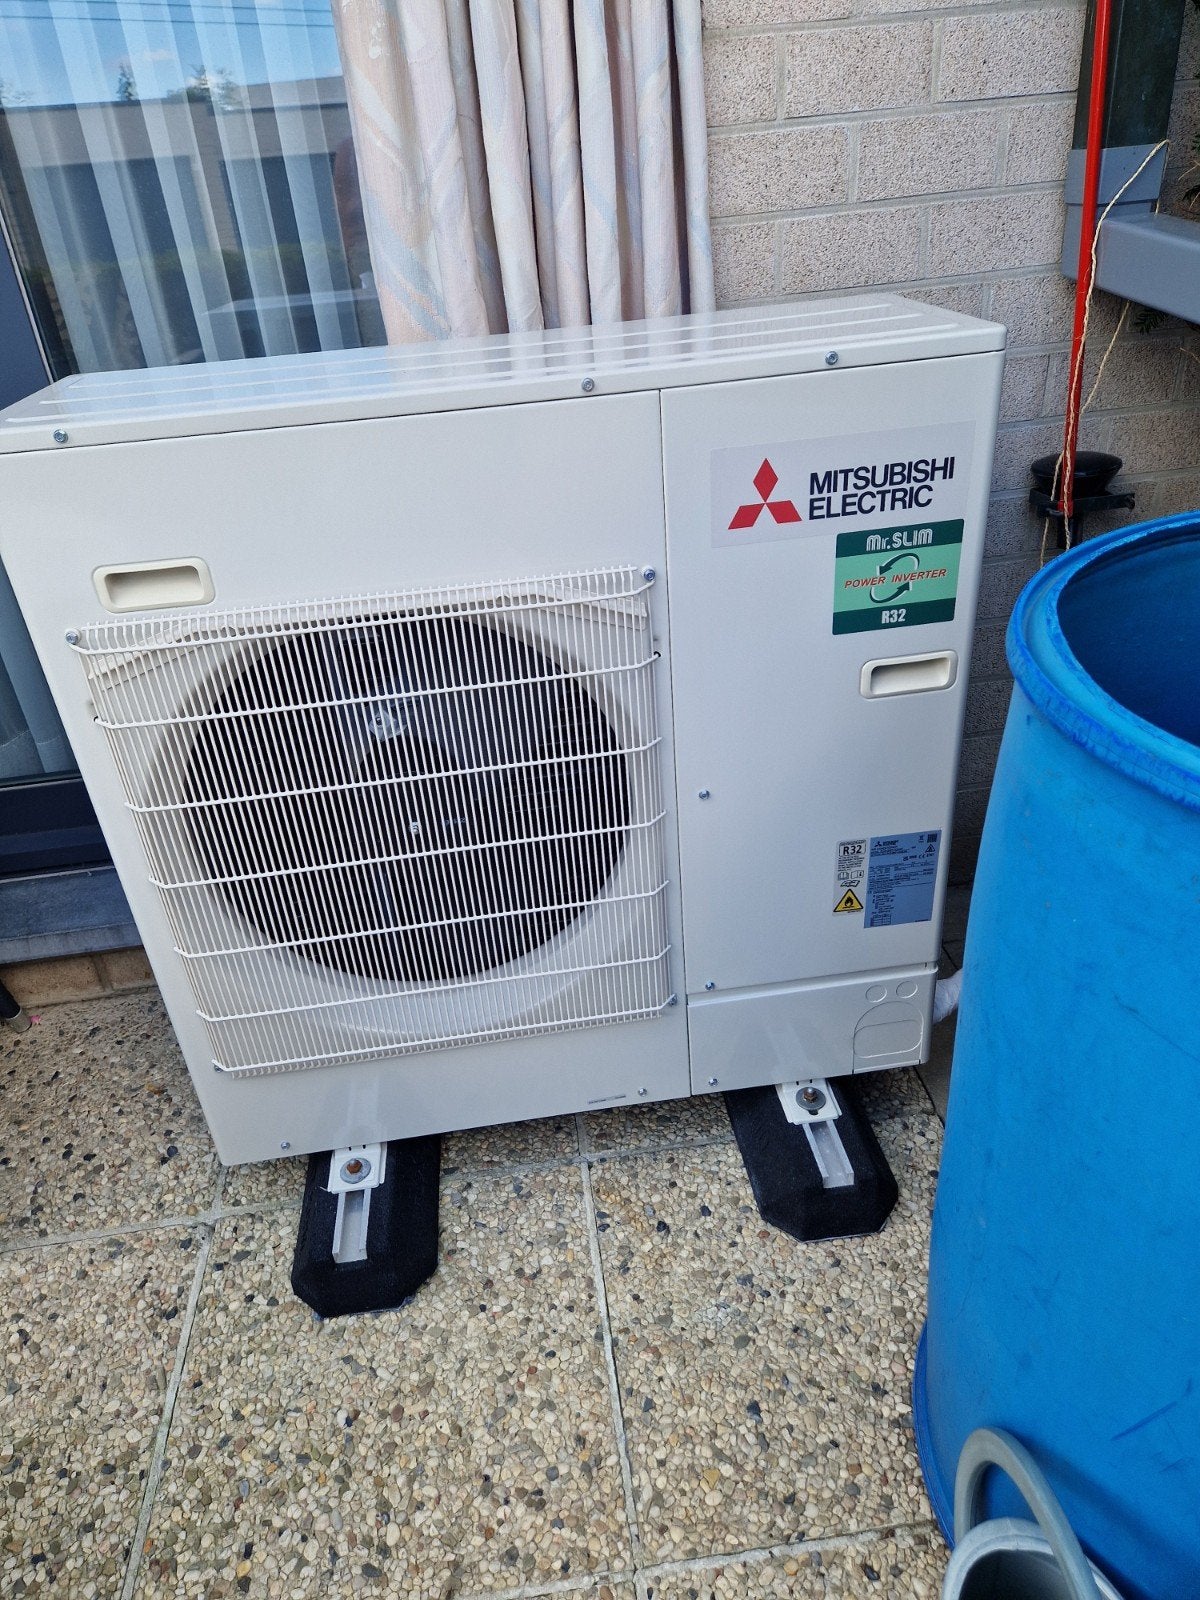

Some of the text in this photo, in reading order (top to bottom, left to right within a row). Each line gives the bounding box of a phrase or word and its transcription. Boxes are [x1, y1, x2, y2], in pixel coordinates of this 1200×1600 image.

[809, 456, 955, 496] MITSUBISHI
[808, 484, 934, 520] ELECTRIC
[844, 568, 947, 589] POWER INVERTER
[881, 608, 907, 624] R32
